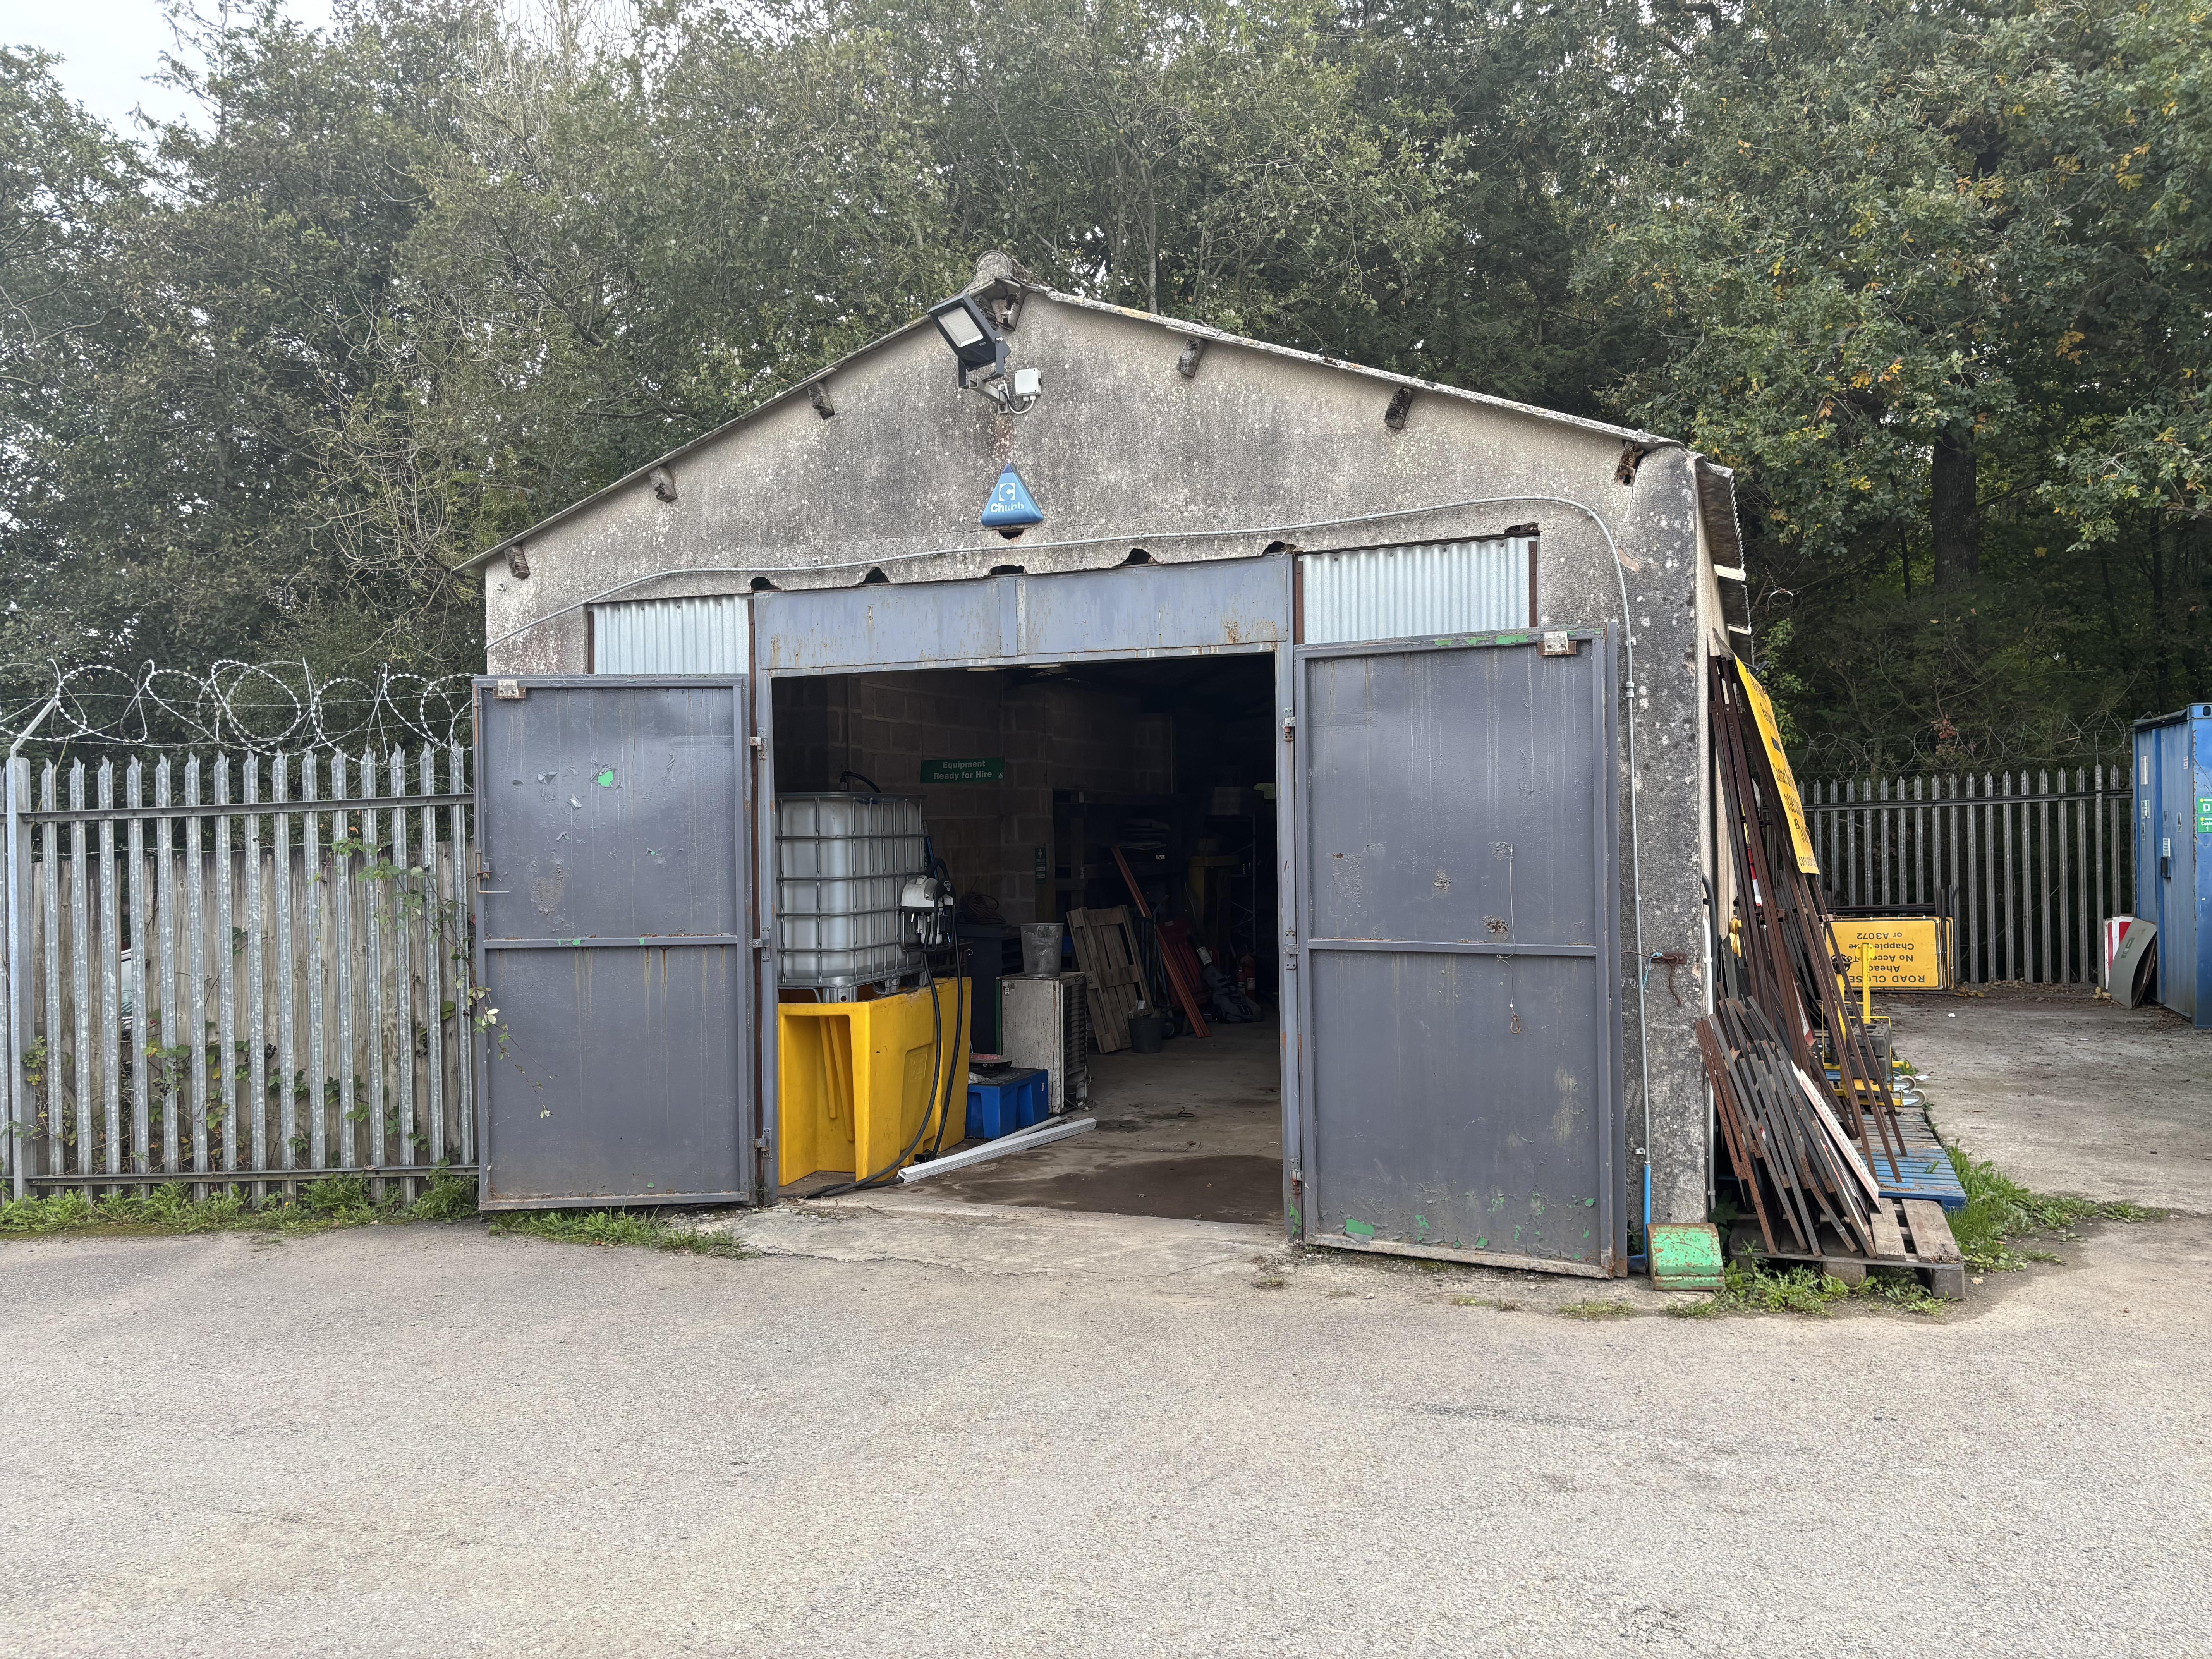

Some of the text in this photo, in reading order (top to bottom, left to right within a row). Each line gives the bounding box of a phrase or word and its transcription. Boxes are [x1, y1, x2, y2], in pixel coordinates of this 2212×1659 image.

[990, 501, 1024, 513] Chubb
[942, 760, 986, 770] Equipment
[933, 772, 959, 780] Ready
[2203, 803, 2210, 812] D
[1874, 942, 1914, 950] Chapple
